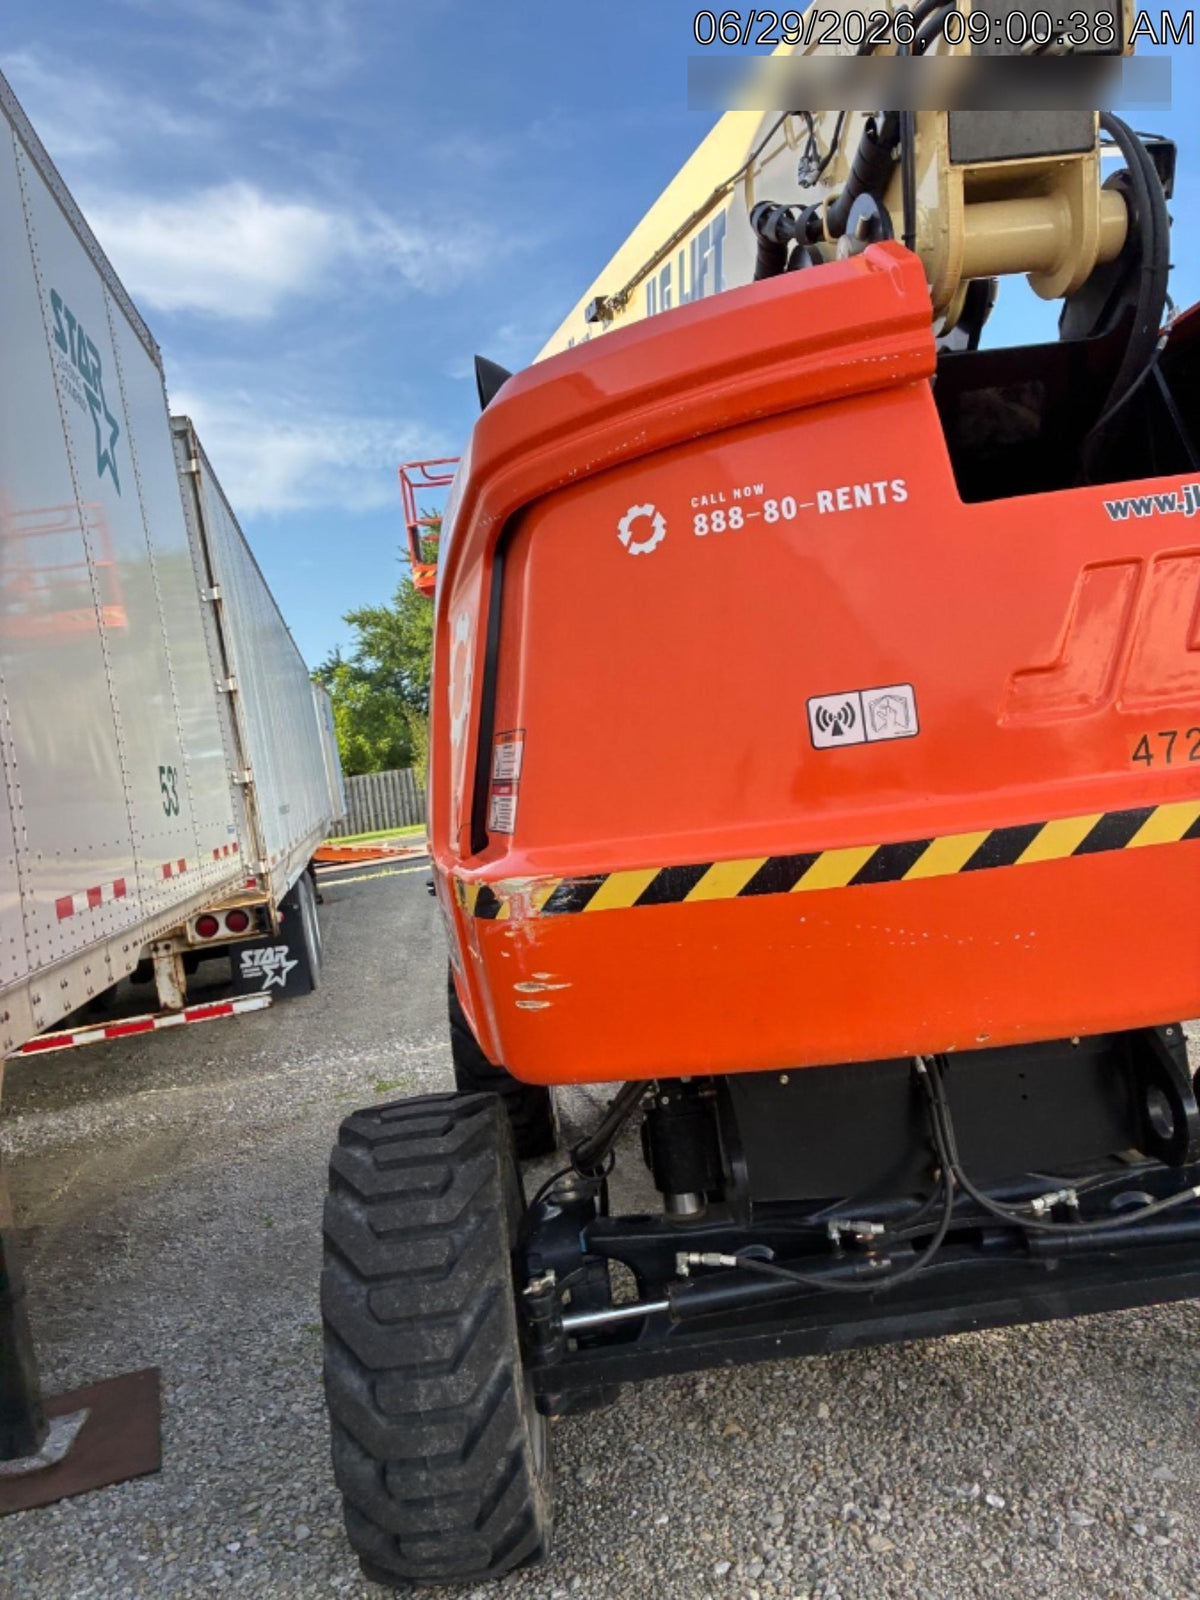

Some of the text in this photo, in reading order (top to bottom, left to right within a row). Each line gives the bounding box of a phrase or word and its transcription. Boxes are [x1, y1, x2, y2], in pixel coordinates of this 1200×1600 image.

[678, 208, 727, 306] LIFT
[50, 287, 102, 394] STAR
[690, 483, 765, 508] CALL NOW
[693, 478, 909, 537] 888-80-RENTS
[1132, 726, 1200, 767] 472
[239, 945, 290, 969] STAR
